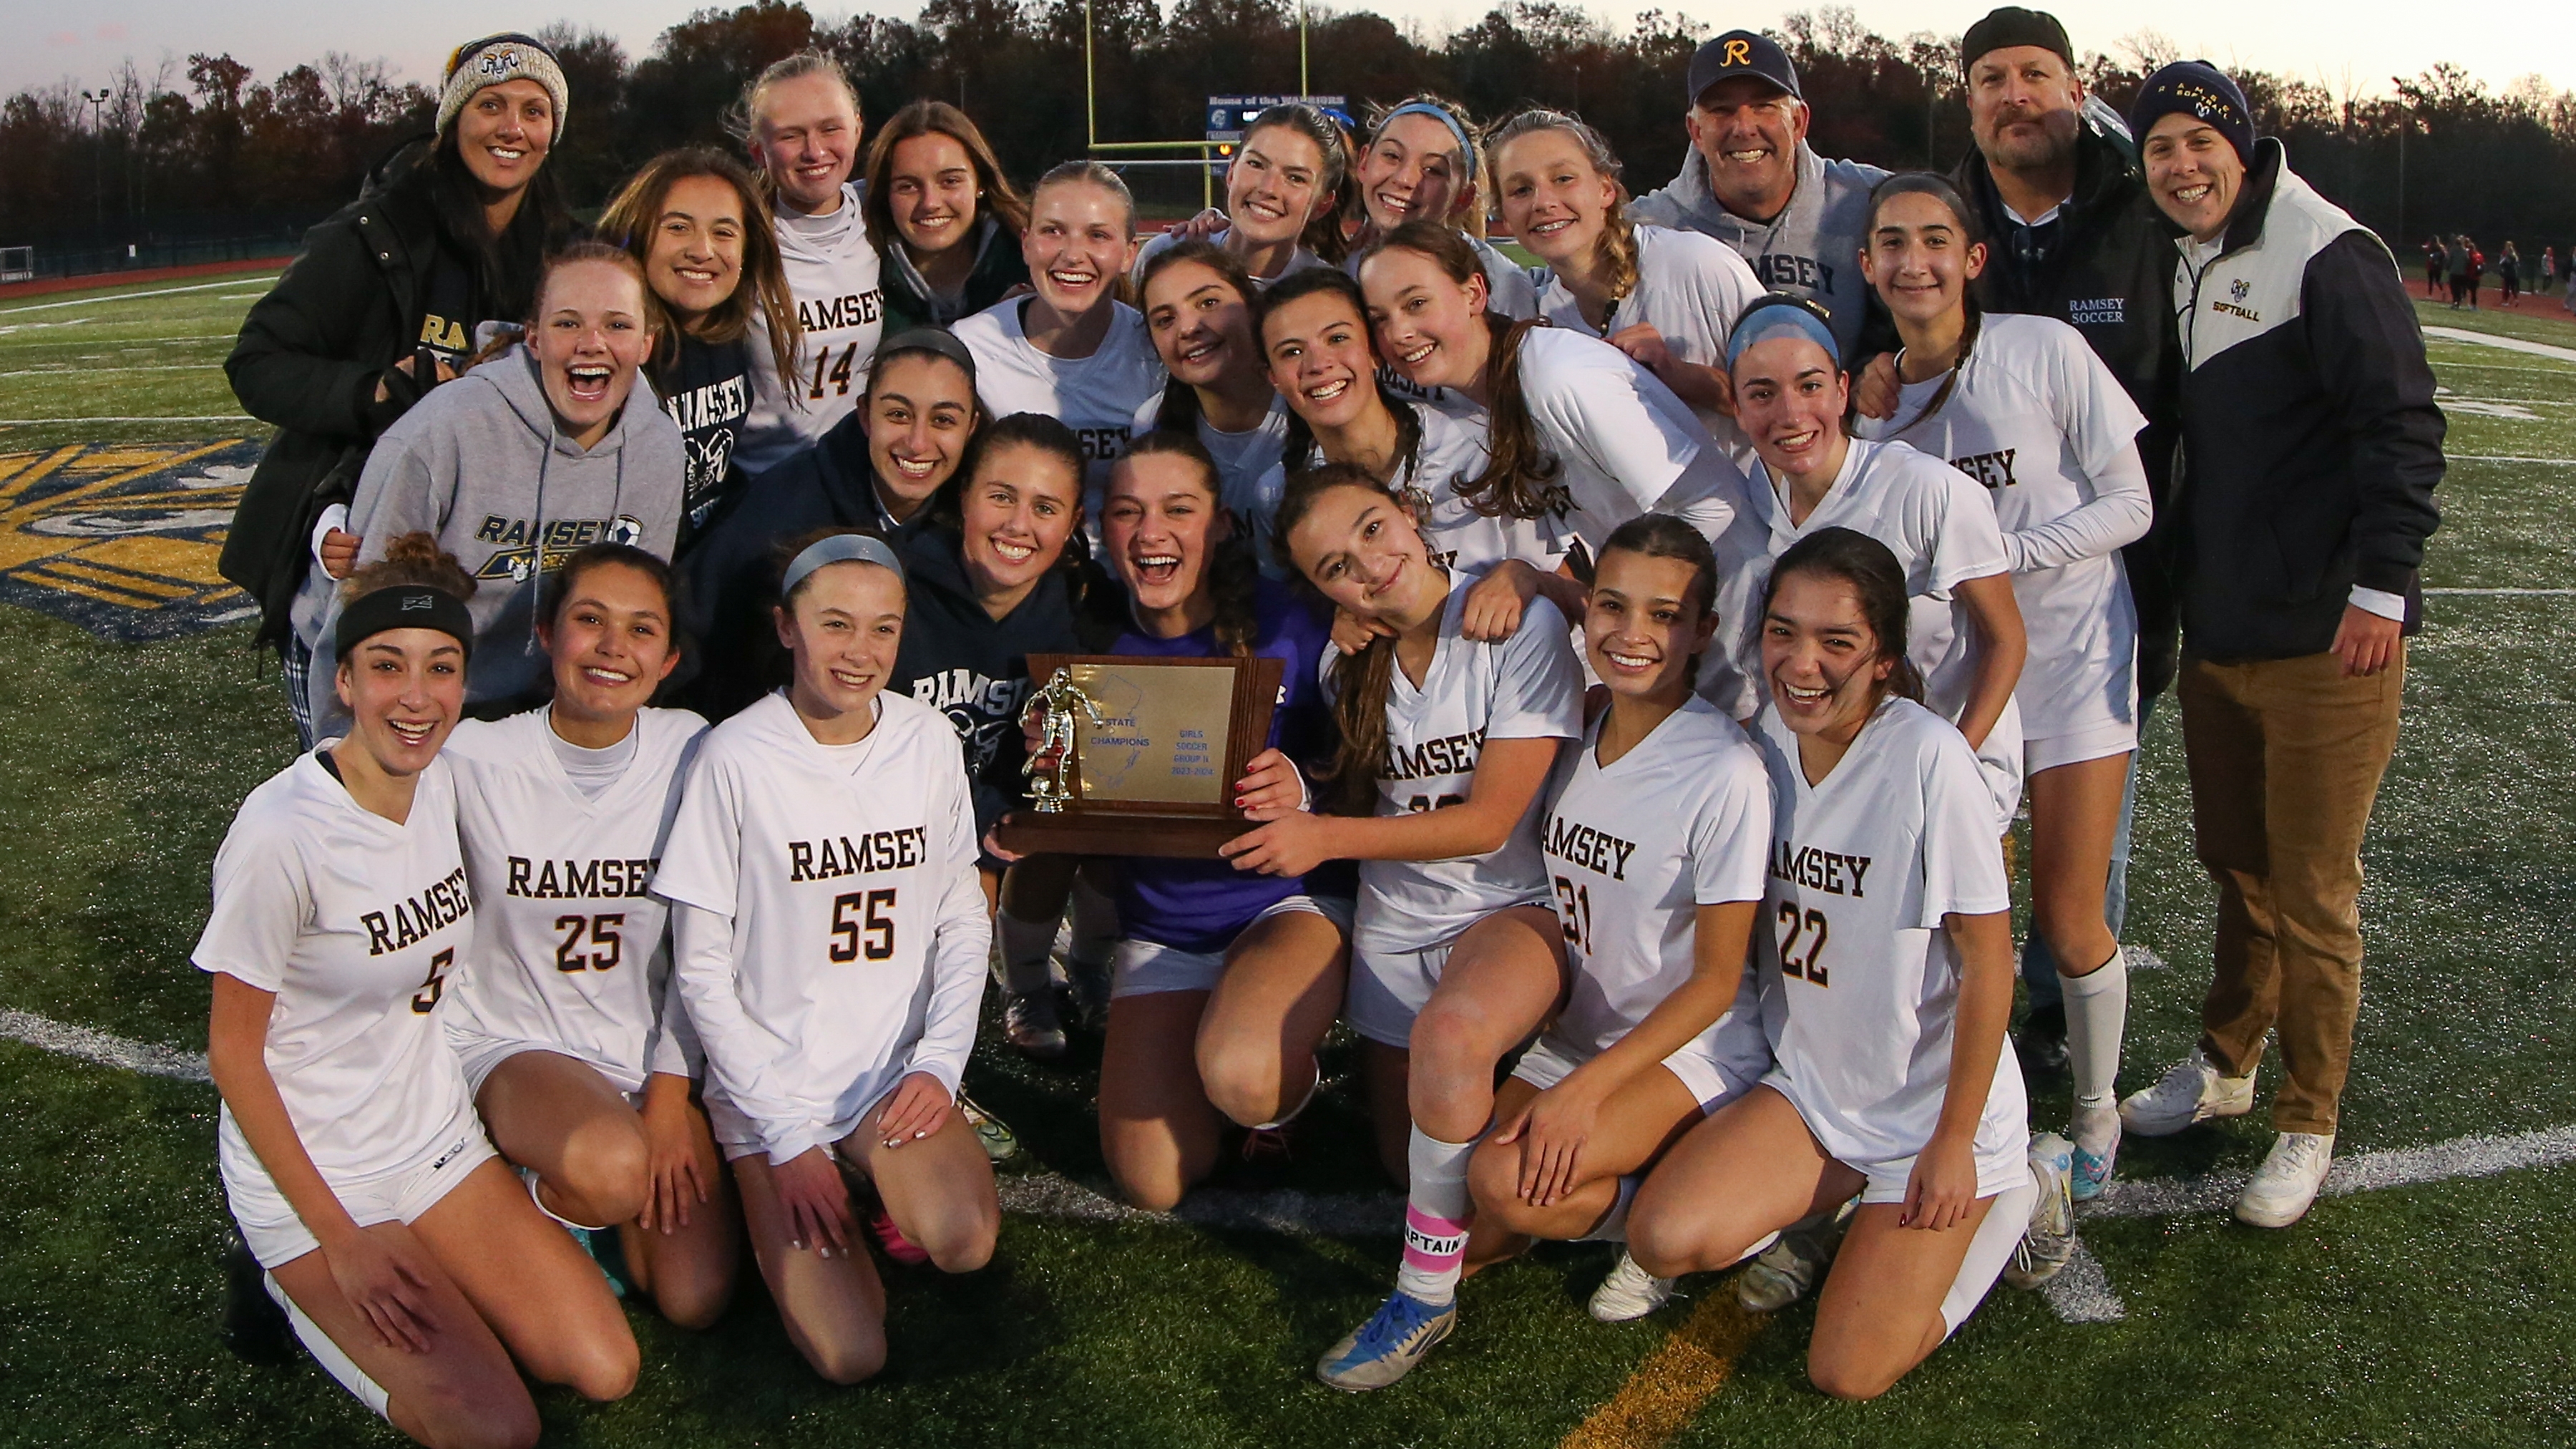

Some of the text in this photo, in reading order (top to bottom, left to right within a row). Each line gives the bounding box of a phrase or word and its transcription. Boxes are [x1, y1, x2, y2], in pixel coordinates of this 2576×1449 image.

[1719, 39, 1750, 67] R
[1209, 96, 1242, 105] Home
[1244, 96, 1256, 105] of
[1259, 96, 1278, 105] the
[1747, 253, 1835, 296] MSEY
[799, 288, 884, 333] AMSEY
[2069, 298, 2124, 311] RAMSEY
[2072, 311, 2124, 323] SOCCER
[2213, 301, 2260, 321] SOFTBALL
[809, 341, 858, 399] 14
[1949, 448, 2016, 489] SEY
[1091, 736, 1150, 747] CHAMPIONS
[1105, 718, 1136, 727] STATE
[1180, 730, 1204, 738] GIRLS
[1174, 754, 1201, 763] GROUP
[1176, 742, 1207, 751] SOCCER
[1382, 726, 1485, 781] AMSEY
[1171, 766, 1214, 776] 2023-2024
[789, 825, 927, 882] RAMSEY
[1542, 811, 1636, 882] AMSEY
[1768, 836, 1872, 897] AMSEY
[829, 887, 897, 964] 55
[1555, 874, 1592, 956] 31
[555, 912, 626, 974] 25
[1779, 899, 1830, 989] 22
[411, 945, 454, 1015] 5
[1405, 1226, 1461, 1253] APTAIN
